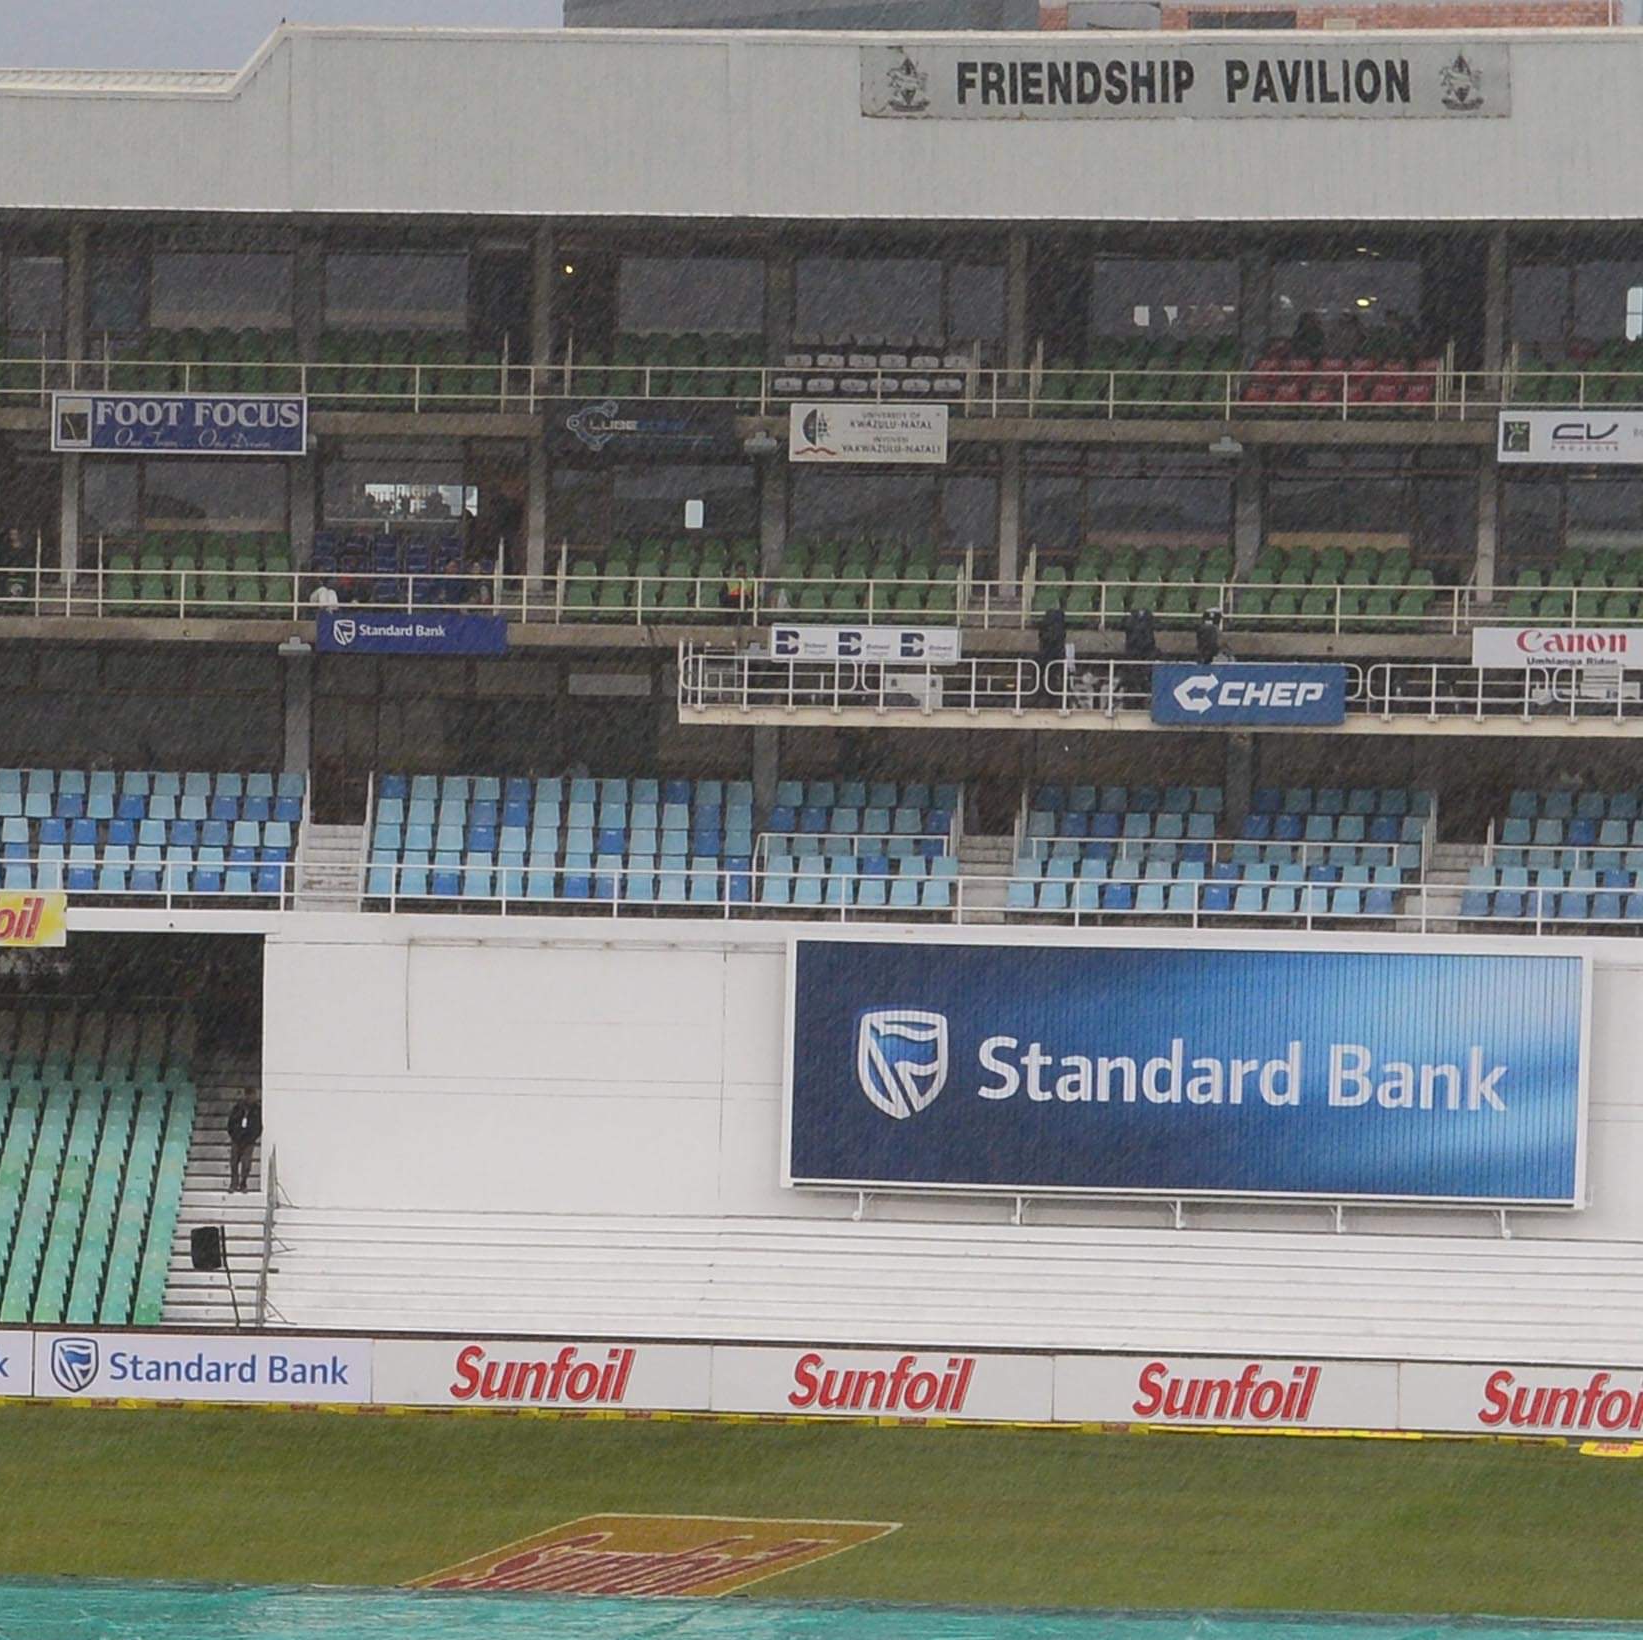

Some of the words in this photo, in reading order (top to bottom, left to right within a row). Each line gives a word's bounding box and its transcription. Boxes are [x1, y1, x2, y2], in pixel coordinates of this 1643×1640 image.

[957, 60, 1195, 106] FRIENDSHIP
[1226, 59, 1412, 105] PAVILION
[96, 401, 184, 426] FOOT
[194, 402, 300, 428] FOCUS
[359, 624, 413, 637] Standard
[416, 625, 445, 637] Bank
[1516, 629, 1627, 653] Canon
[1218, 681, 1324, 706] CHEP
[978, 1036, 1301, 1105] Standard
[1328, 1043, 1507, 1112] Bank
[110, 1352, 257, 1383] Standard
[269, 1356, 348, 1386] Bank
[448, 1343, 635, 1403] Sunfoil
[787, 1351, 974, 1413] Sunfoil
[1132, 1359, 1320, 1422] Sunfoil
